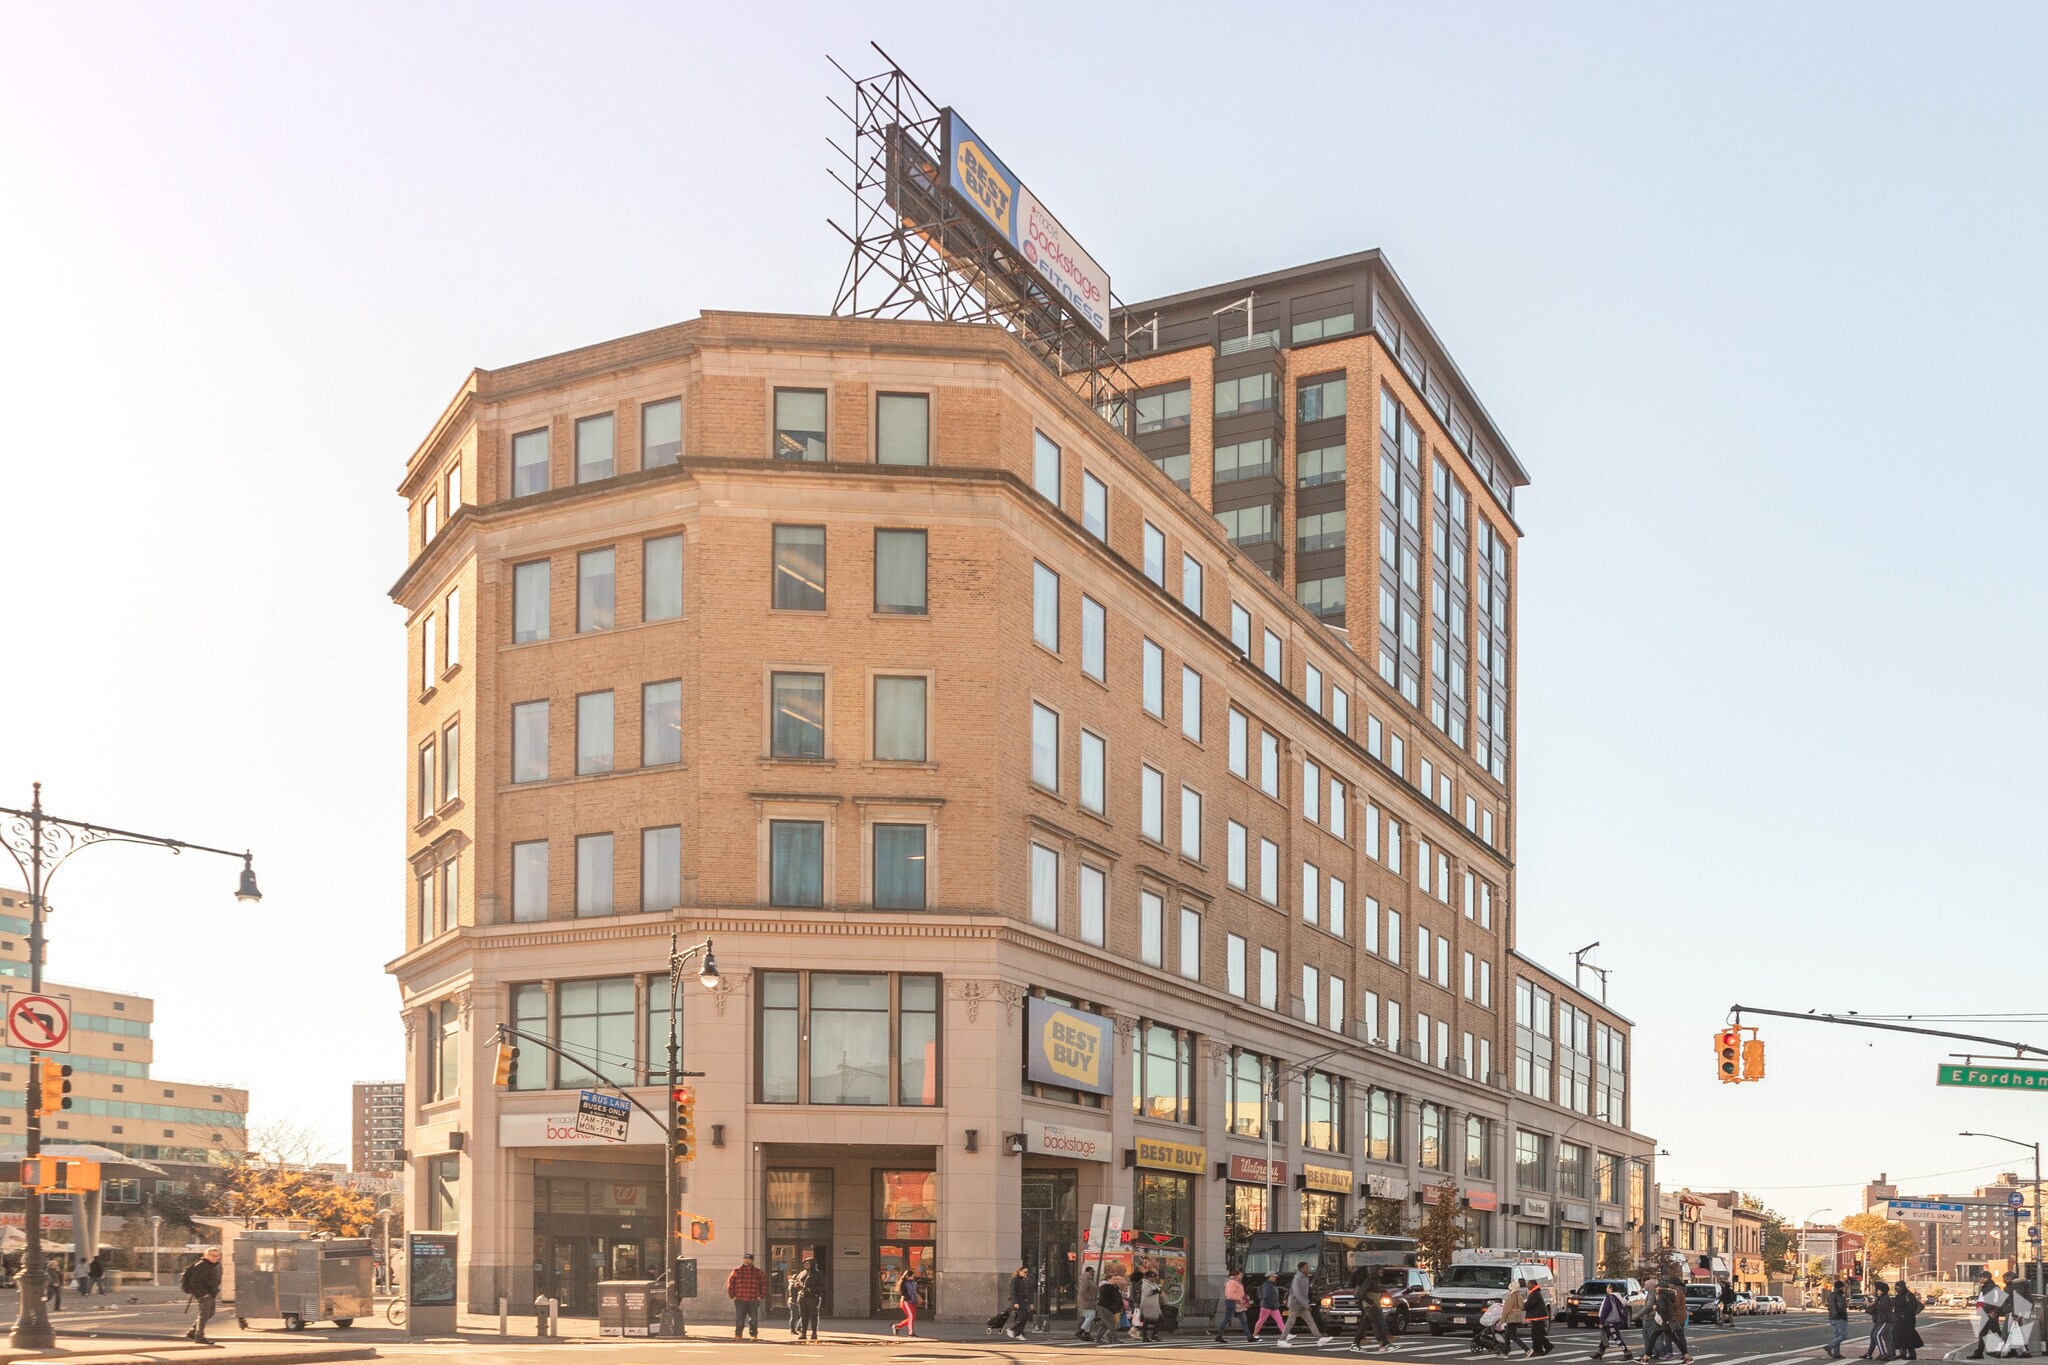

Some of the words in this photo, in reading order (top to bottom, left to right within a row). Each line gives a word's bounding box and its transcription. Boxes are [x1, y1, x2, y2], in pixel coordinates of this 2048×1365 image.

[965, 147, 1008, 204] BEST
[965, 171, 1004, 221] BUY
[1029, 217, 1101, 302] backstage
[1039, 259, 1104, 330] FITNESS
[1052, 1020, 1097, 1053] BEST
[1053, 1043, 1092, 1072] BUY
[1952, 1070, 1962, 1081] E
[1968, 1071, 2048, 1086] Fordham
[583, 1101, 607, 1113] BUSES
[608, 1107, 626, 1117] ONLY
[592, 1095, 608, 1105] BUS
[610, 1099, 630, 1110] LANE
[1044, 1132, 1096, 1158] backstage
[1140, 1144, 1173, 1163] BEST
[1176, 1150, 1202, 1166] BUY
[1241, 1158, 1279, 1180] Walgres
[1307, 1170, 1330, 1185] BEST
[1332, 1174, 1350, 1187] BUY
